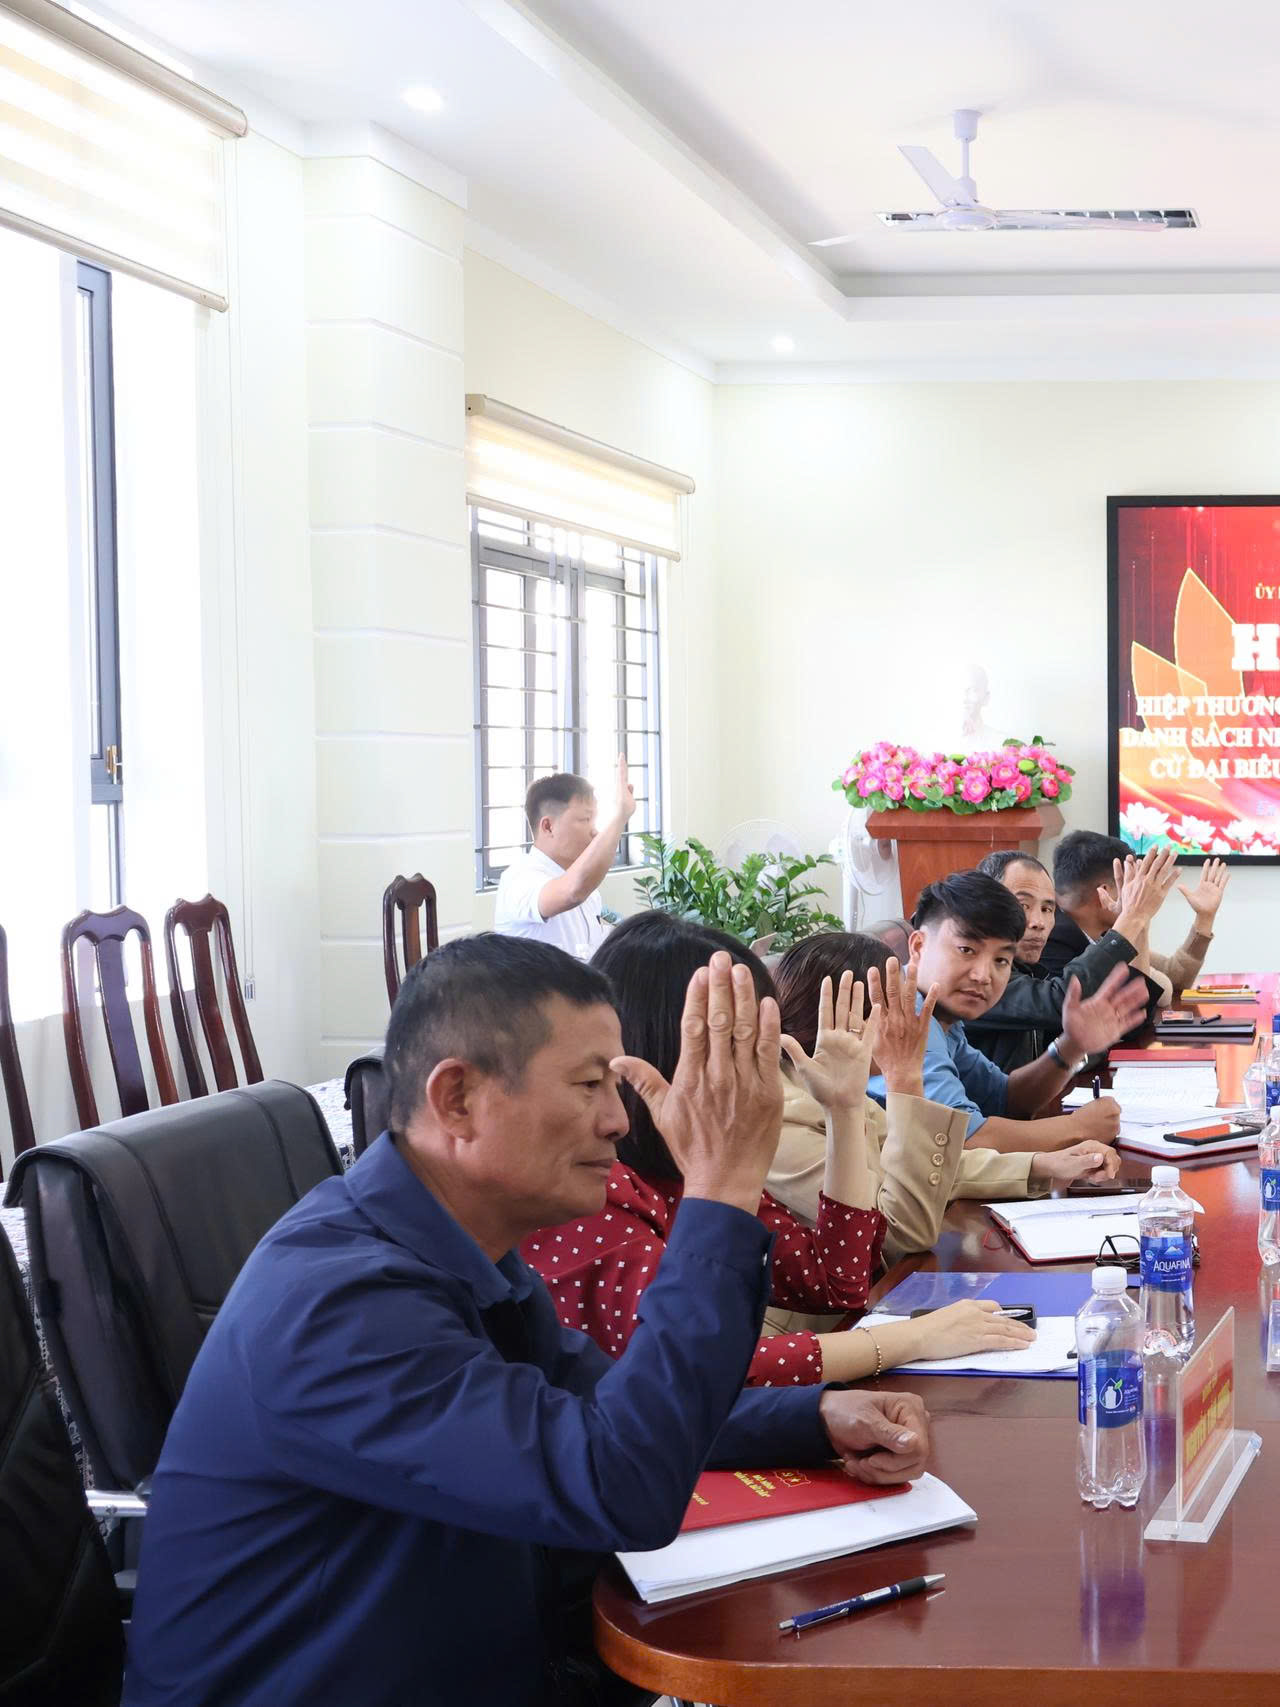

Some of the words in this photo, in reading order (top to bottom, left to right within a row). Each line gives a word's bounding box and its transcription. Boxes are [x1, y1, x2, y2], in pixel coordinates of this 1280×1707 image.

[1255, 583, 1276, 599] ỦY
[1136, 693, 1191, 720] HIỆP
[1122, 727, 1188, 748] DANH
[1190, 722, 1253, 748] SÁCH
[1187, 758, 1229, 783] ĐẠI
[1153, 1257, 1191, 1272] AQUAFINA
